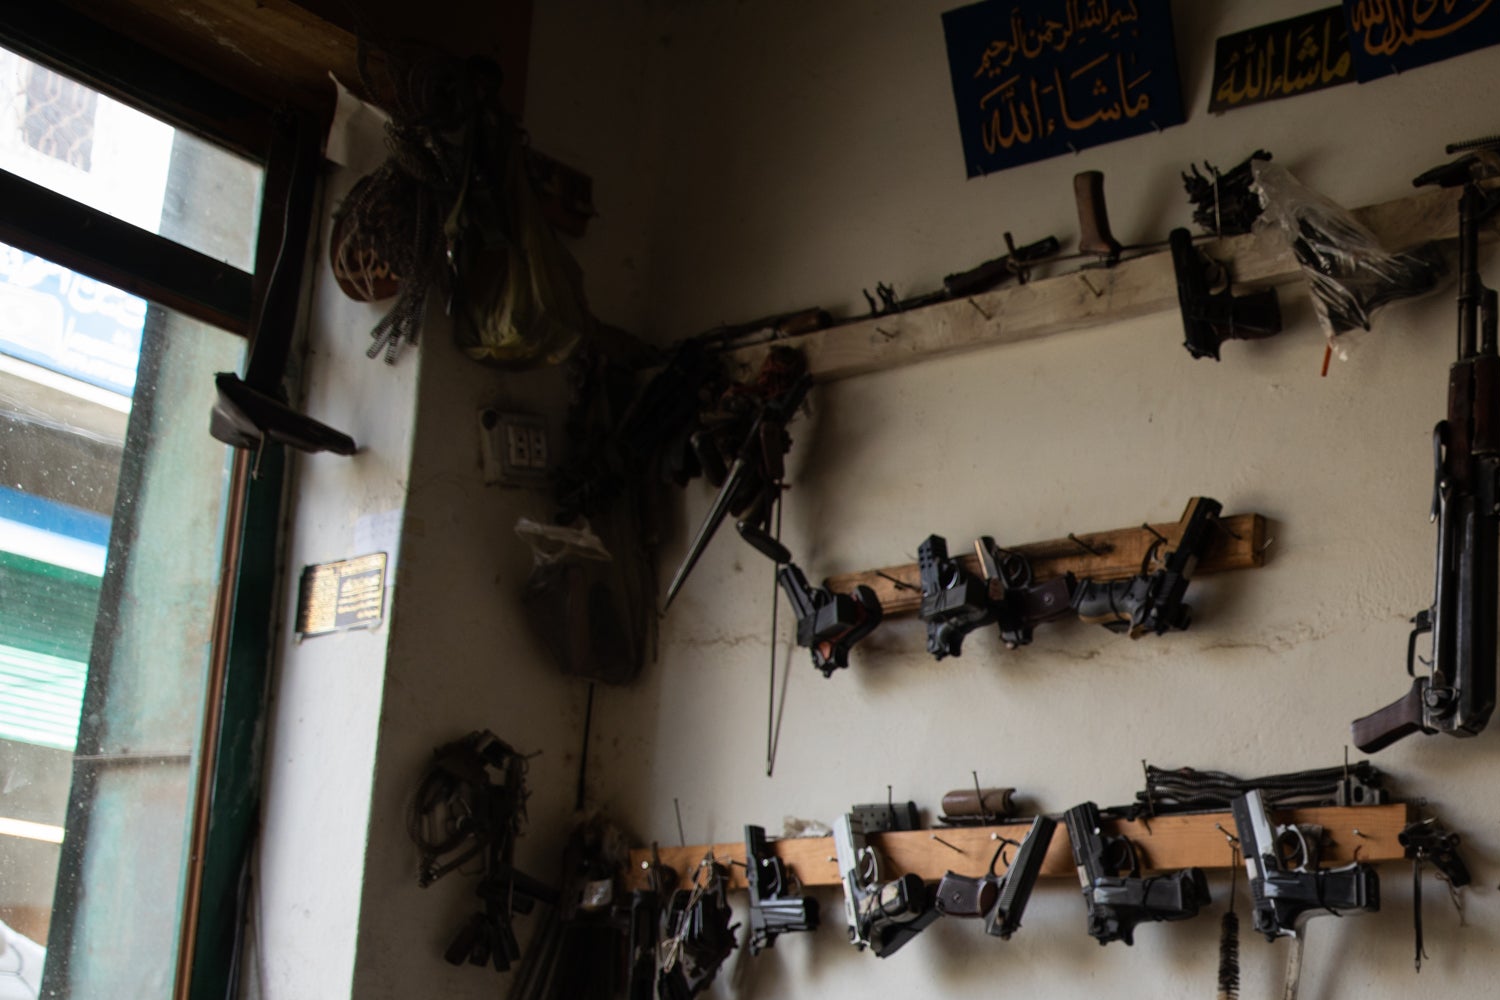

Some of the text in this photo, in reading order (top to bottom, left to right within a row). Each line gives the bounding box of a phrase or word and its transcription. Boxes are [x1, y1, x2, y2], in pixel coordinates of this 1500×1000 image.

[973, 6, 1023, 79] الرحيم
[1215, 34, 1276, 103] الله
[980, 74, 1043, 154] الله
